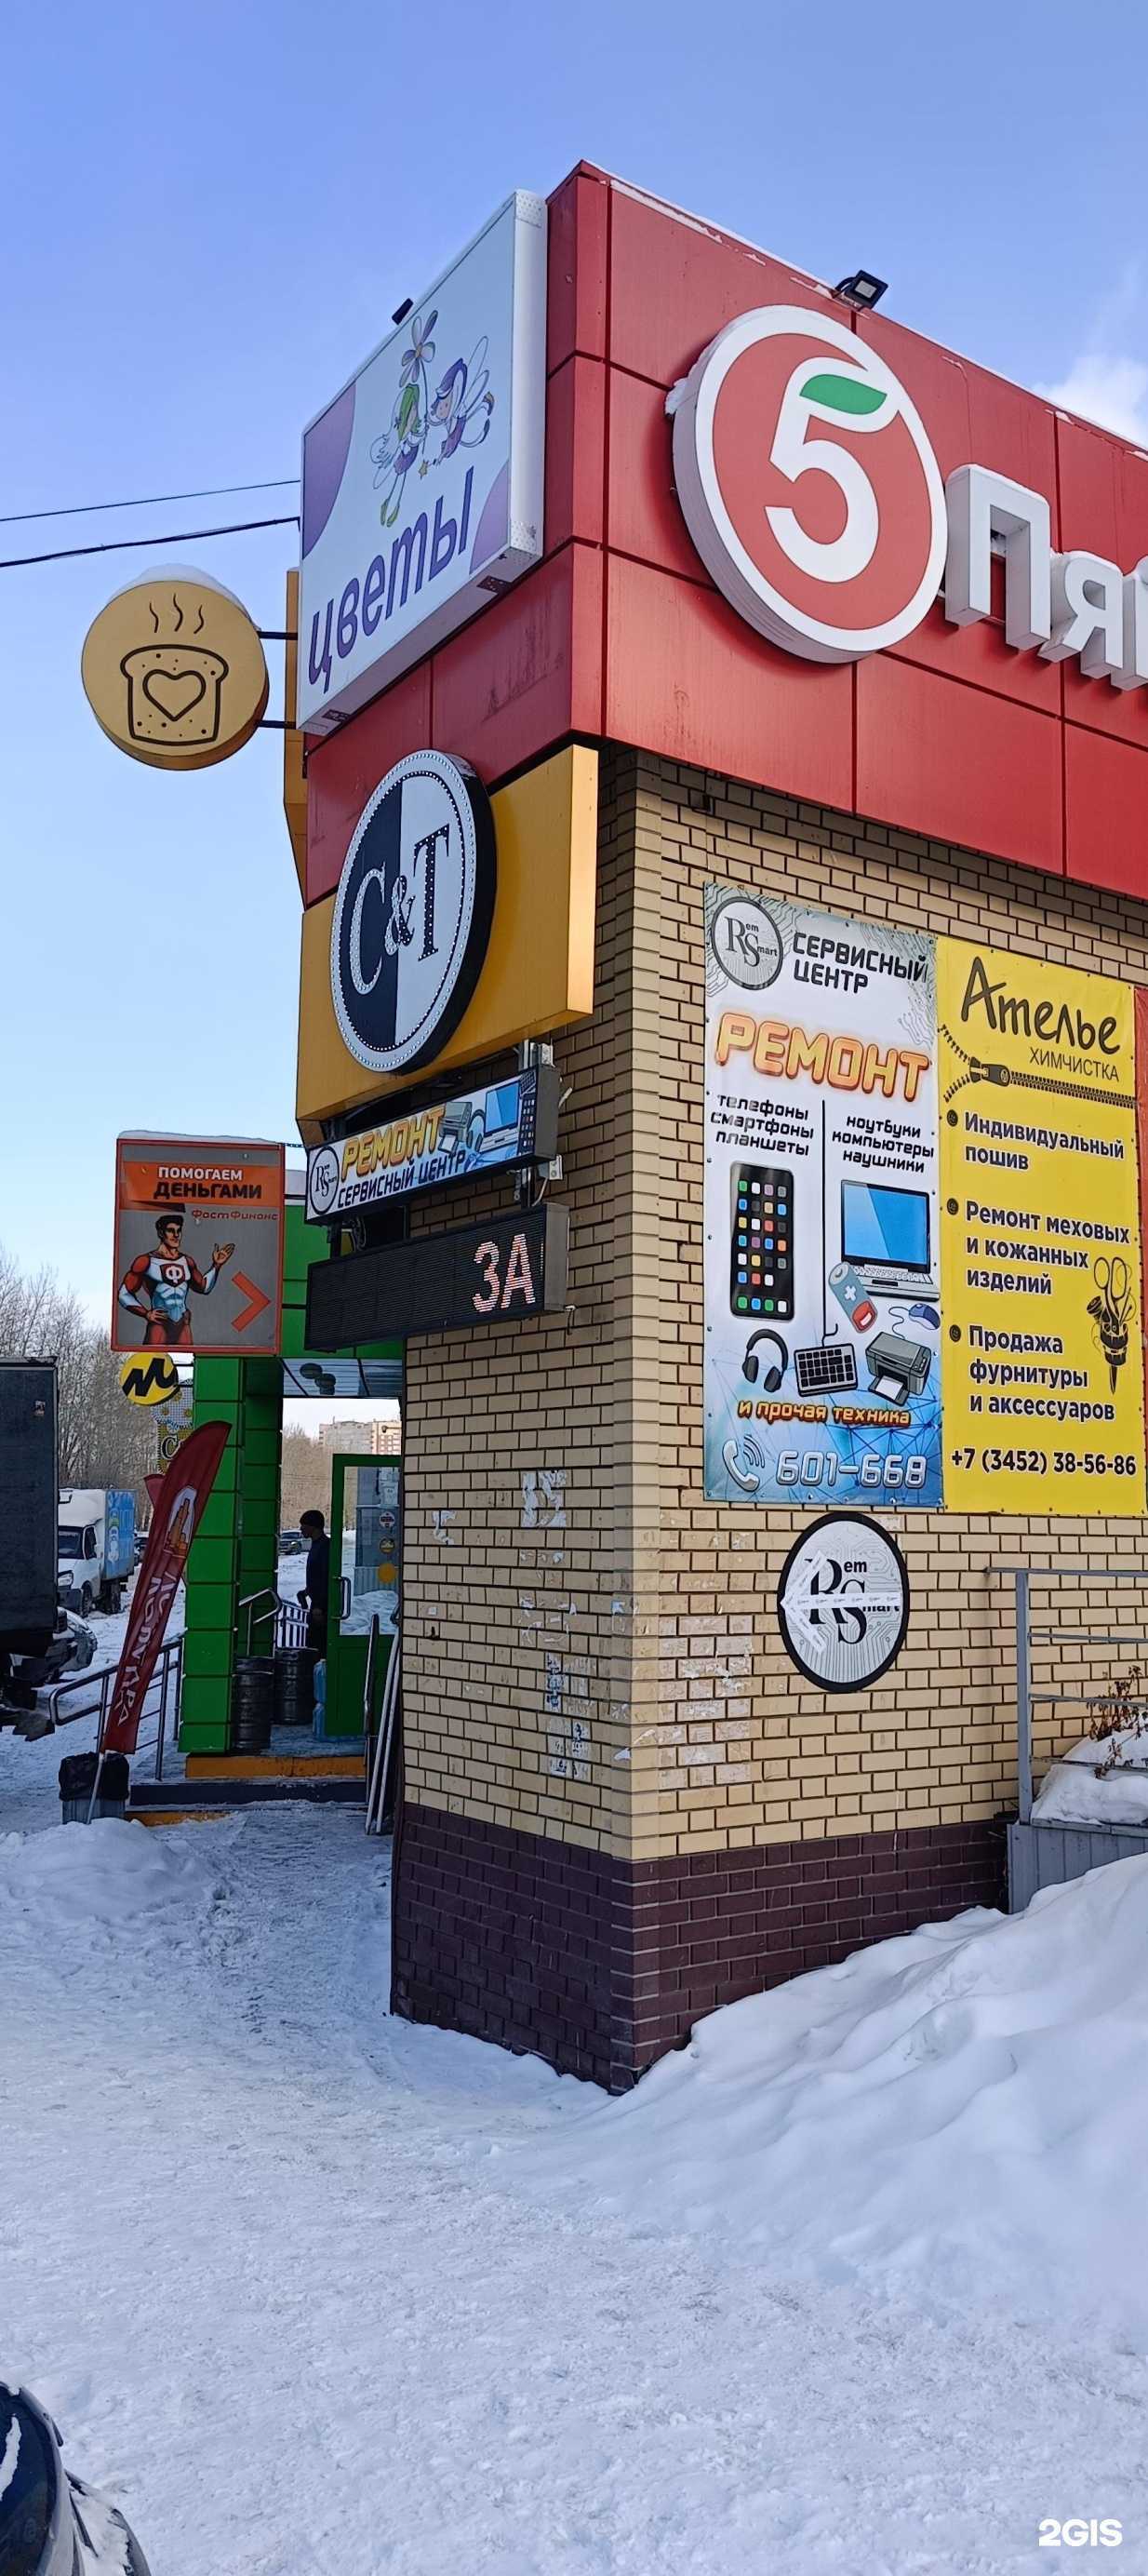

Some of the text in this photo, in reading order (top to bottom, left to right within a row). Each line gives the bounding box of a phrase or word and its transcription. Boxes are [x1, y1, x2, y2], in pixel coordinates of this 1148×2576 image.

[308, 466, 474, 694] цветы
[943, 463, 1148, 689] Пя
[349, 823, 450, 996] C&T
[793, 932, 928, 984] СЕРВИСНЫЙ
[794, 959, 868, 994] ЦЕНТР
[961, 956, 1121, 1054] Ателье
[714, 1012, 930, 1102] РЕМОНТ
[1029, 1047, 1119, 1081] ХИМЧИСТКА
[717, 1094, 808, 1120] телефоны
[711, 1112, 814, 1139] смартфоны
[846, 1115, 921, 1139] ноутбуки
[965, 1112, 1124, 1160] Индивидуальный
[340, 1105, 447, 1183] РЕМОНТ
[715, 1131, 809, 1156] планшеты
[832, 1131, 934, 1158] компьютеры
[965, 1146, 1029, 1171] пошив
[158, 1167, 243, 1181] ПОМОГАЕМ
[843, 1149, 925, 1173] наушники
[154, 1181, 261, 1200] ДЕНЬГАМИ
[338, 1161, 415, 1208] СЕРВИСНЫЙ
[417, 1150, 465, 1184] ЦЕНТР
[967, 1201, 1130, 1244] Ремонт меховых
[967, 1236, 1088, 1268] и кожанных
[473, 1233, 543, 1312] ЗА
[968, 1269, 1052, 1295] изделий
[969, 1324, 1063, 1354] Продажа
[969, 1360, 1088, 1389] фурнитуры
[737, 1400, 912, 1428] и прочая техника
[970, 1395, 1115, 1421] и аксессуаров
[776, 1450, 928, 1489] 601-668
[952, 1448, 1136, 1475] +7 (3452) 38-56-86
